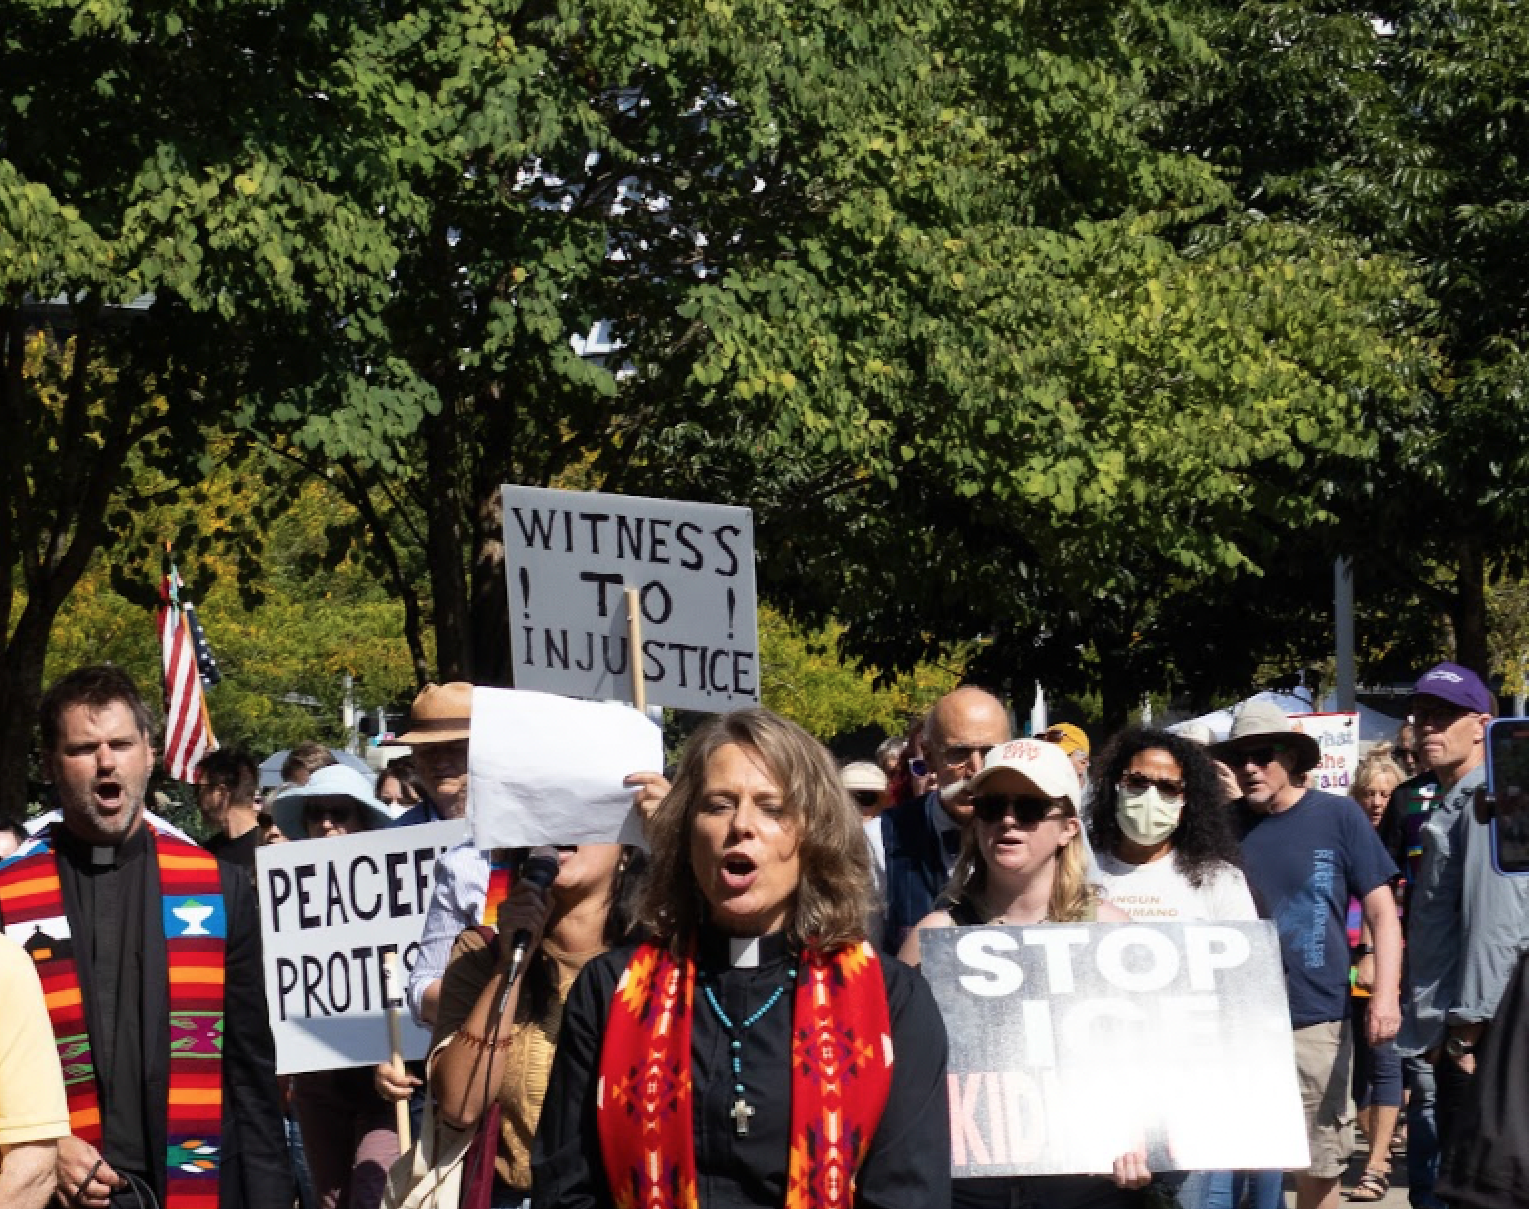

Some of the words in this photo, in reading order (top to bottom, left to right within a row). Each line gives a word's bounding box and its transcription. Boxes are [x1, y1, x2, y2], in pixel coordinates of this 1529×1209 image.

[511, 507, 741, 577] WITNESS
[579, 571, 673, 624] TO
[1318, 730, 1354, 747] hat
[268, 845, 448, 933] PEACEF
[955, 926, 1250, 997] STOP
